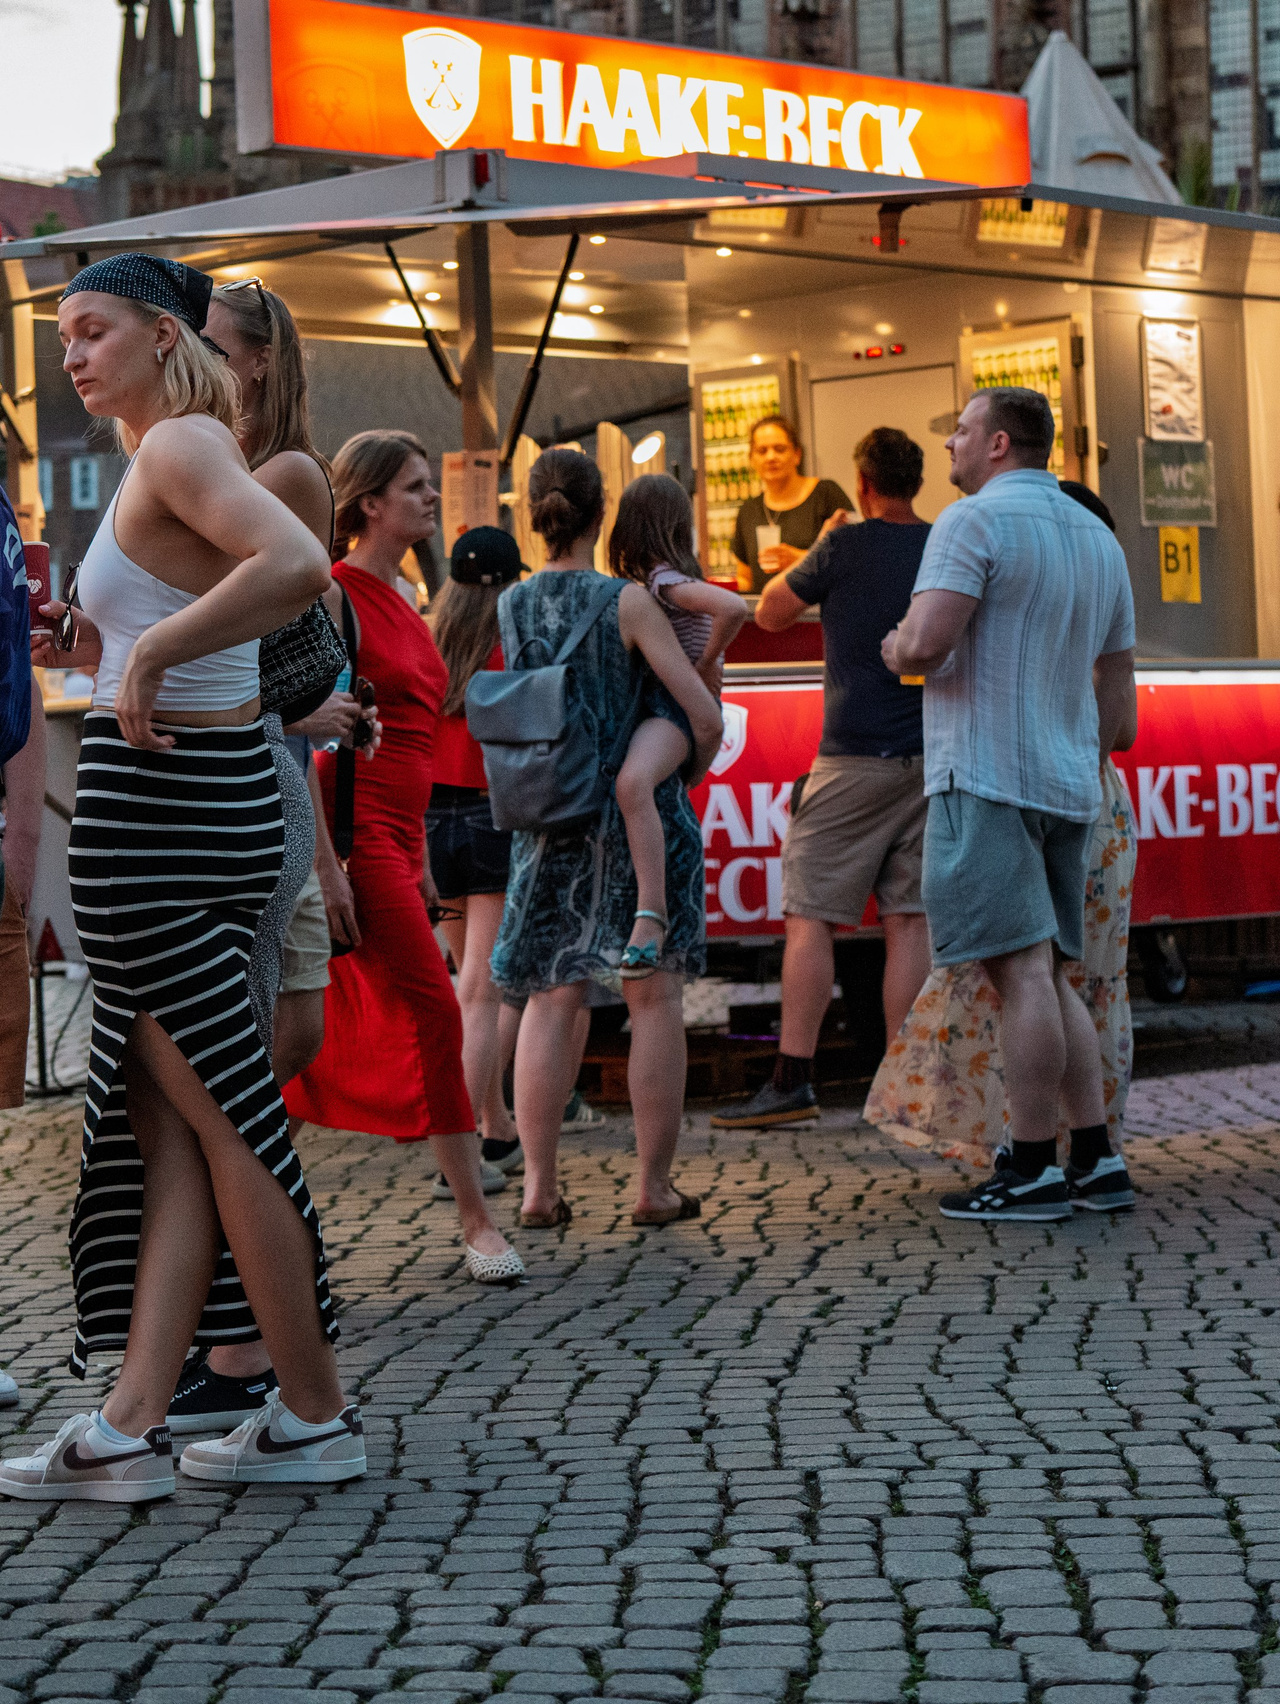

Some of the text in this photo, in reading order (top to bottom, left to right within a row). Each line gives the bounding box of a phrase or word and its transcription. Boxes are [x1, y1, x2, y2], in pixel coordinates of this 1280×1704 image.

[509, 54, 925, 178] HAAKE-BECK
[1160, 462, 1195, 490] WC
[1164, 541, 1192, 574] B1
